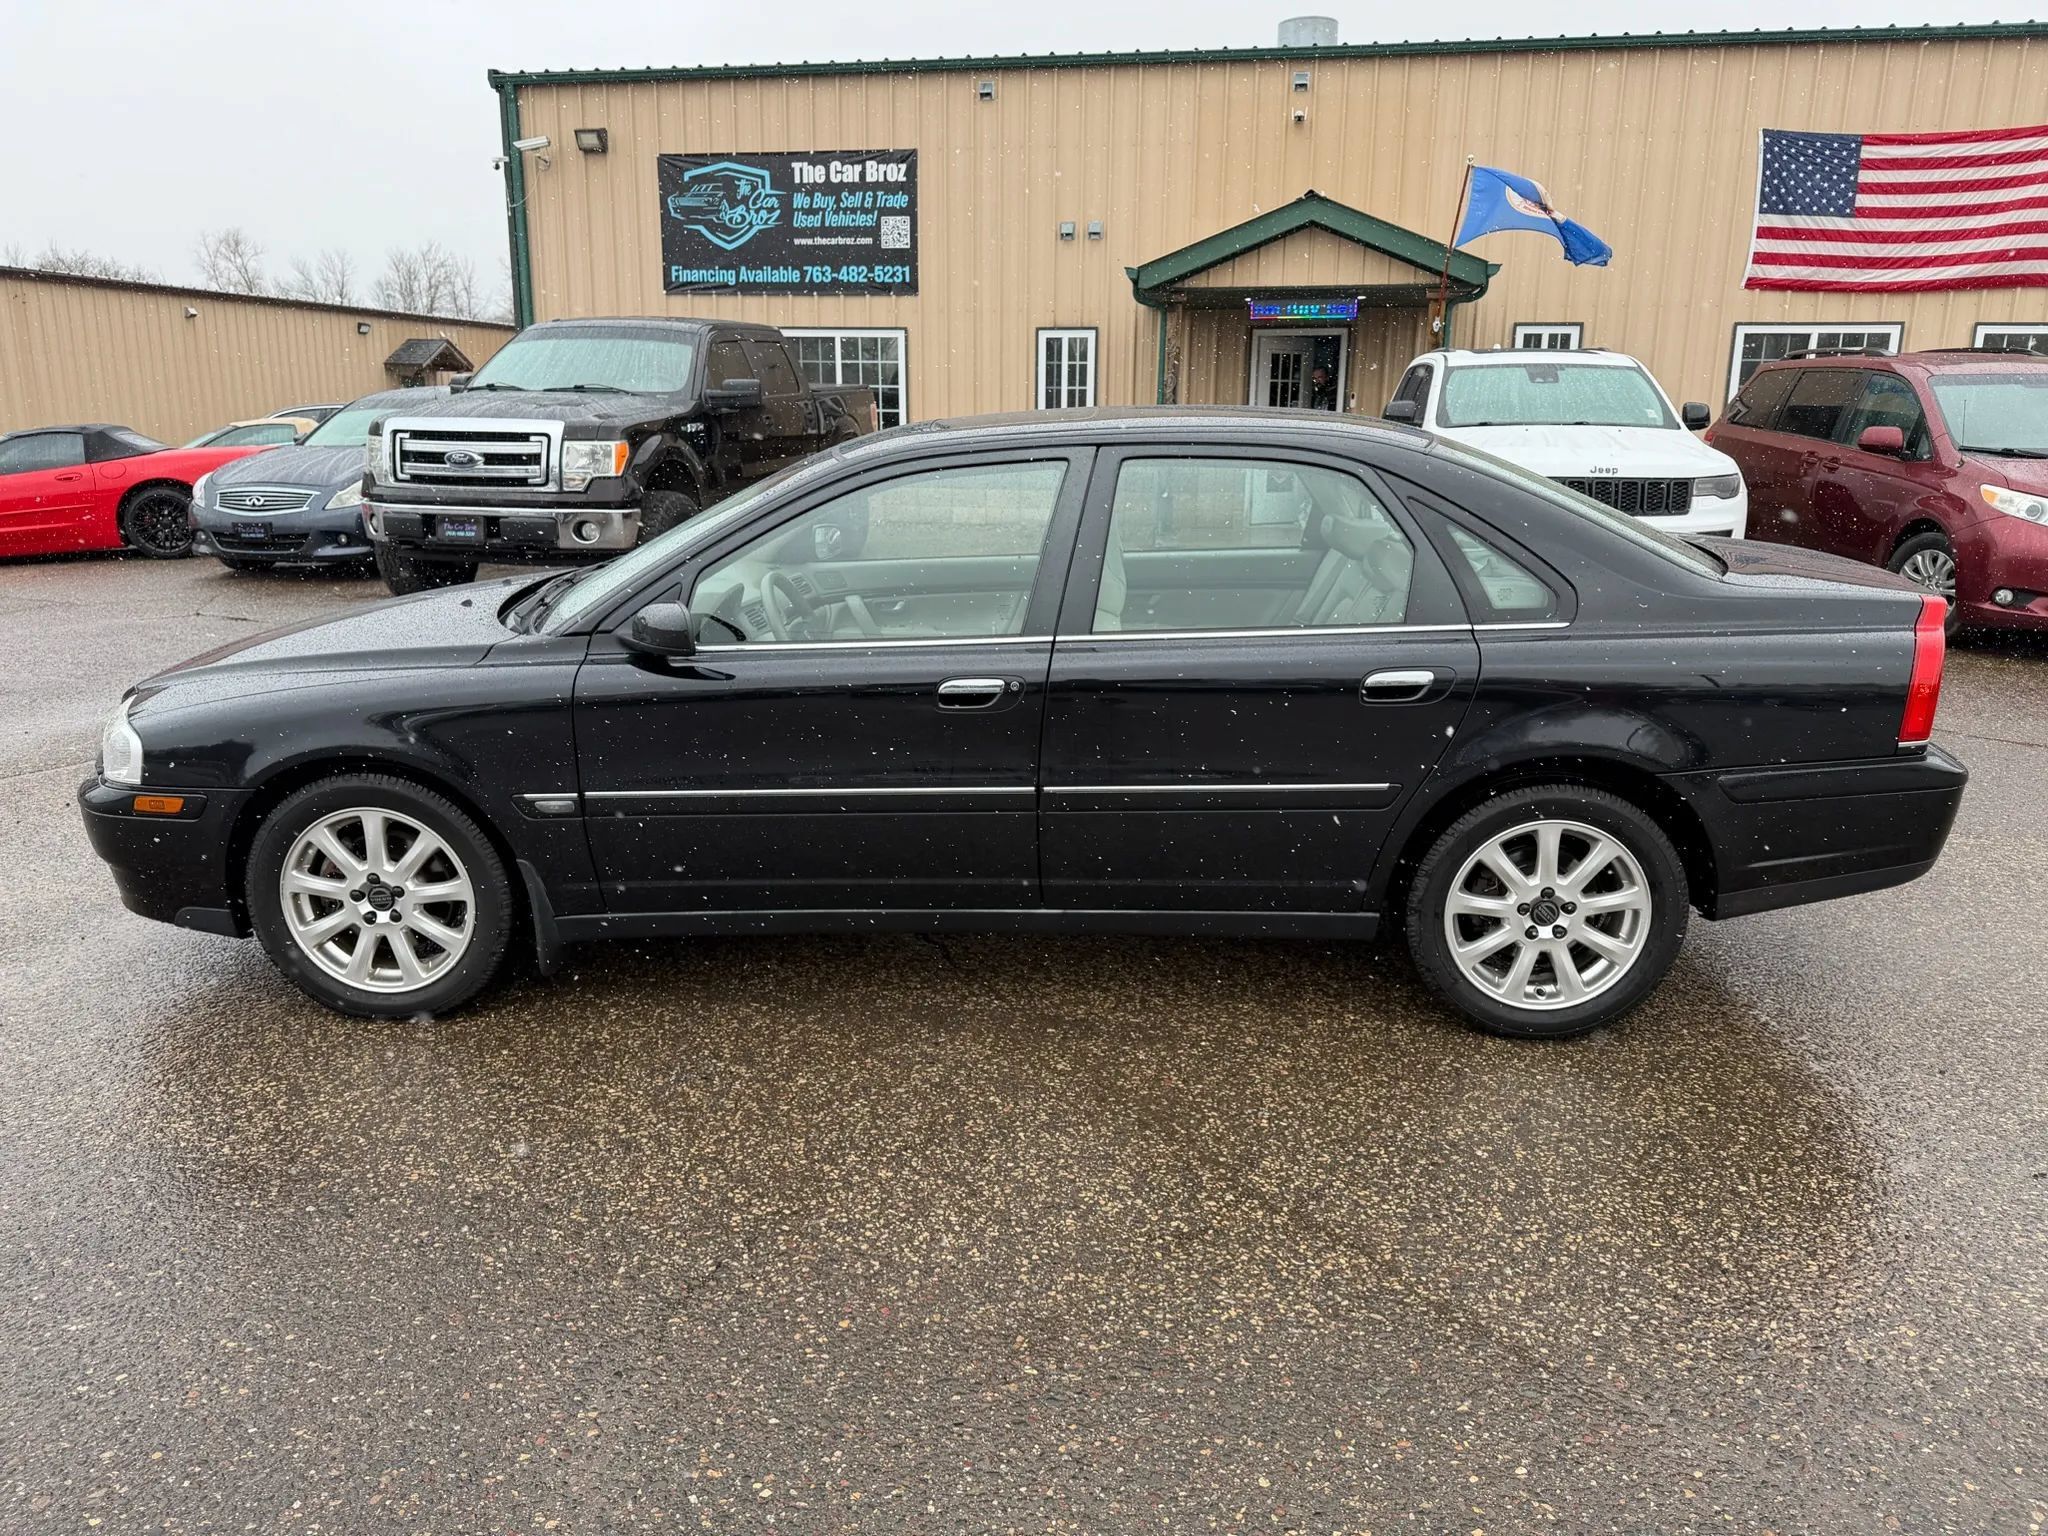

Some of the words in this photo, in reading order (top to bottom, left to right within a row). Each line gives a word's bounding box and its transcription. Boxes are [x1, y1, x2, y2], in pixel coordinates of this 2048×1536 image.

[791, 161, 827, 184] The
[829, 161, 862, 183] Car
[866, 160, 907, 182] Broz
[734, 178, 753, 200] The
[748, 188, 780, 209] Car
[792, 193, 812, 209] We
[813, 192, 838, 212] Buy,
[840, 192, 863, 208] Sell
[864, 192, 874, 208] &
[876, 191, 909, 209] Trade
[726, 204, 784, 228] Broz
[793, 211, 824, 228] Used
[824, 210, 878, 228] Vehicles!
[793, 236, 874, 246] www.thecarbroz.com
[671, 266, 736, 286] Financing
[739, 266, 801, 283] Available
[803, 265, 911, 283] 763-482-5231
[451, 453, 470, 463] Ford
[1590, 465, 1618, 475] Jeep
